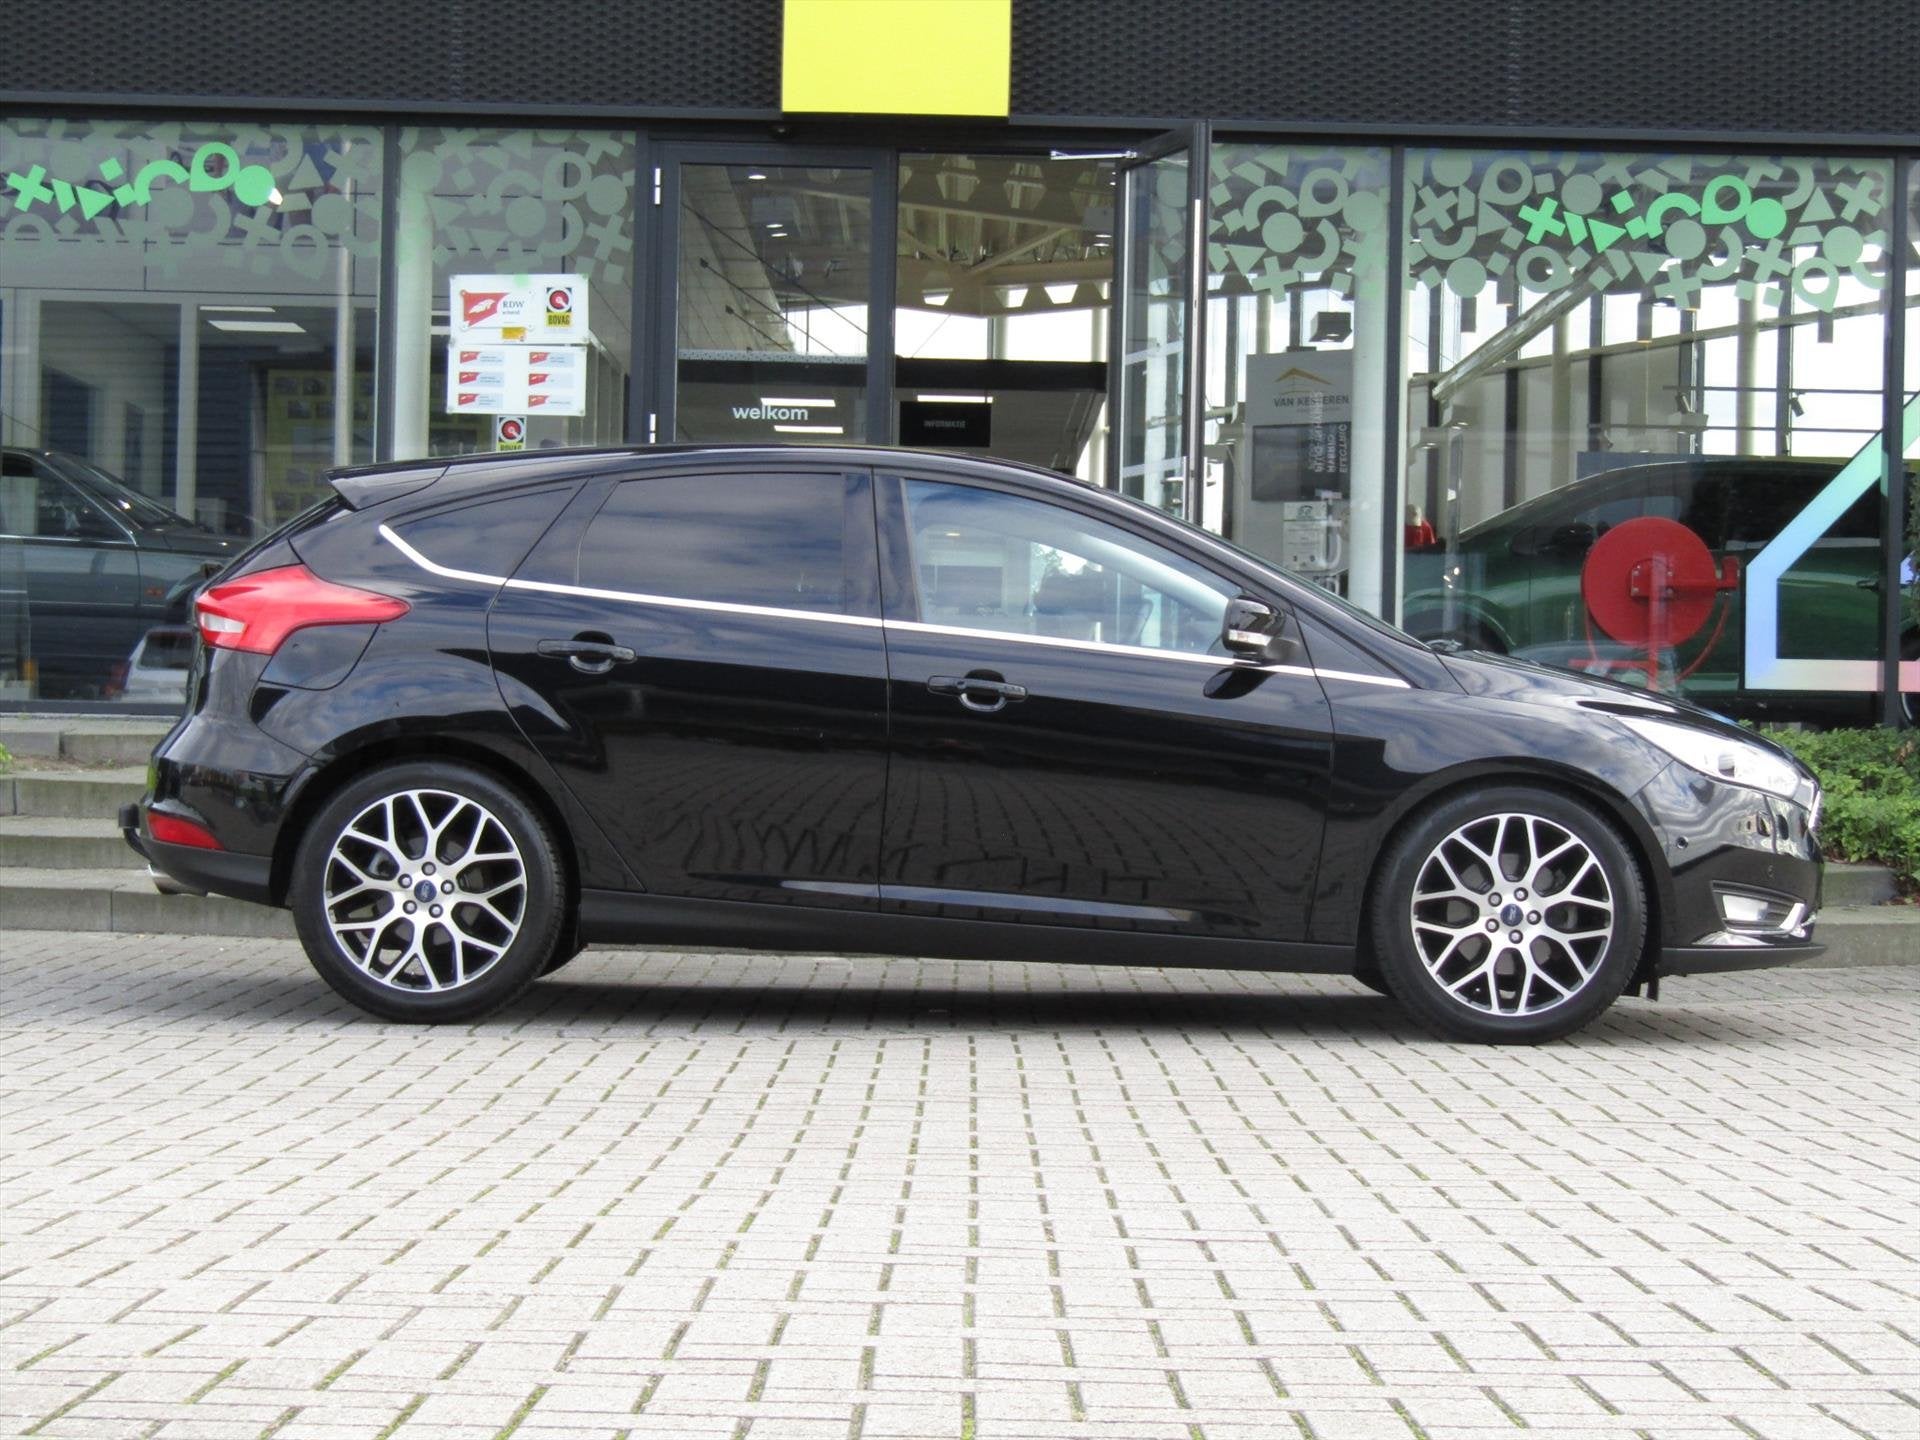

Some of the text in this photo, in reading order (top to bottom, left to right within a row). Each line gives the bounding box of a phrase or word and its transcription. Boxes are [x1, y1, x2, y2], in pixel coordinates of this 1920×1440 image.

[502, 300, 525, 308] RDW
[548, 314, 570, 325] BOVAG
[1273, 397, 1294, 407] VAN
[732, 402, 808, 420] welkom
